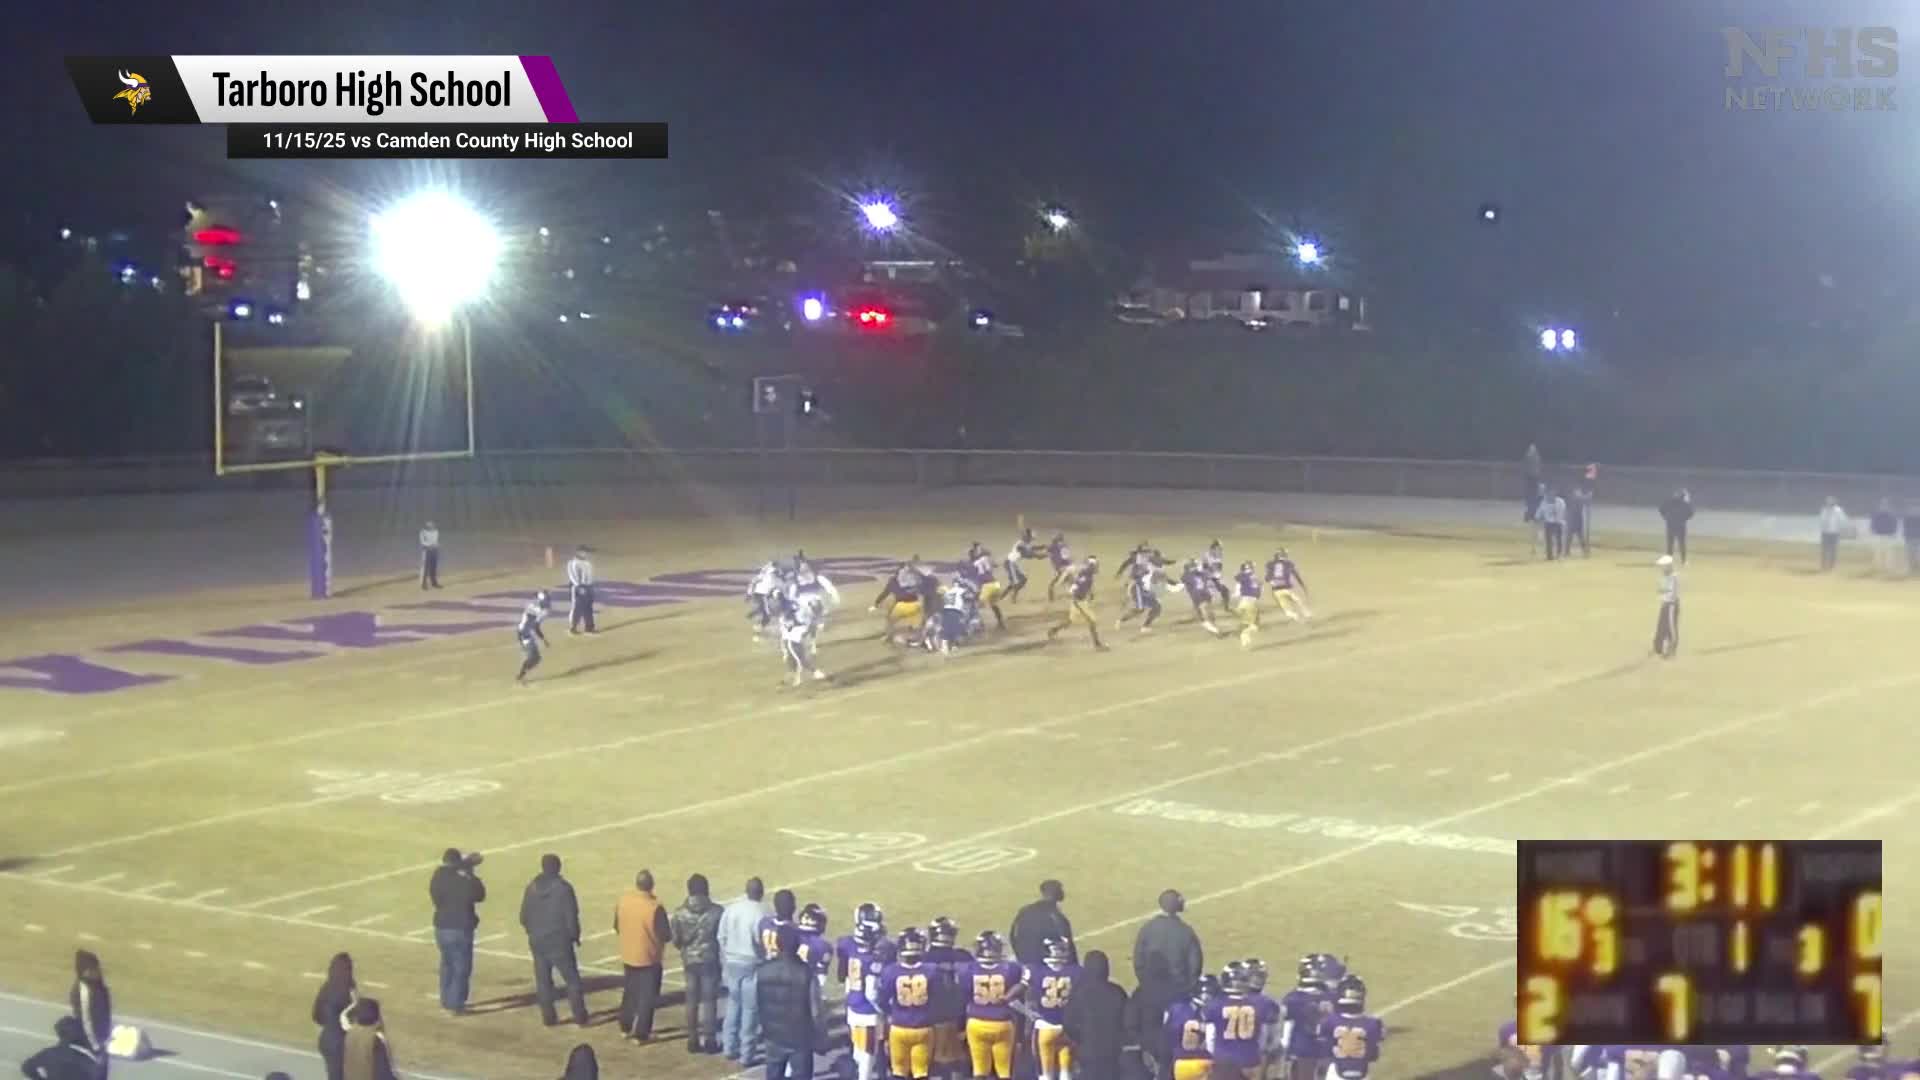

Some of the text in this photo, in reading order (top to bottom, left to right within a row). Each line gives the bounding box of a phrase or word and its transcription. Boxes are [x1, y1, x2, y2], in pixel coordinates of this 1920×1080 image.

[1666, 842, 1779, 910] 3:11
[1222, 1005, 1256, 1040] 70
[1523, 975, 1560, 1044] 2
